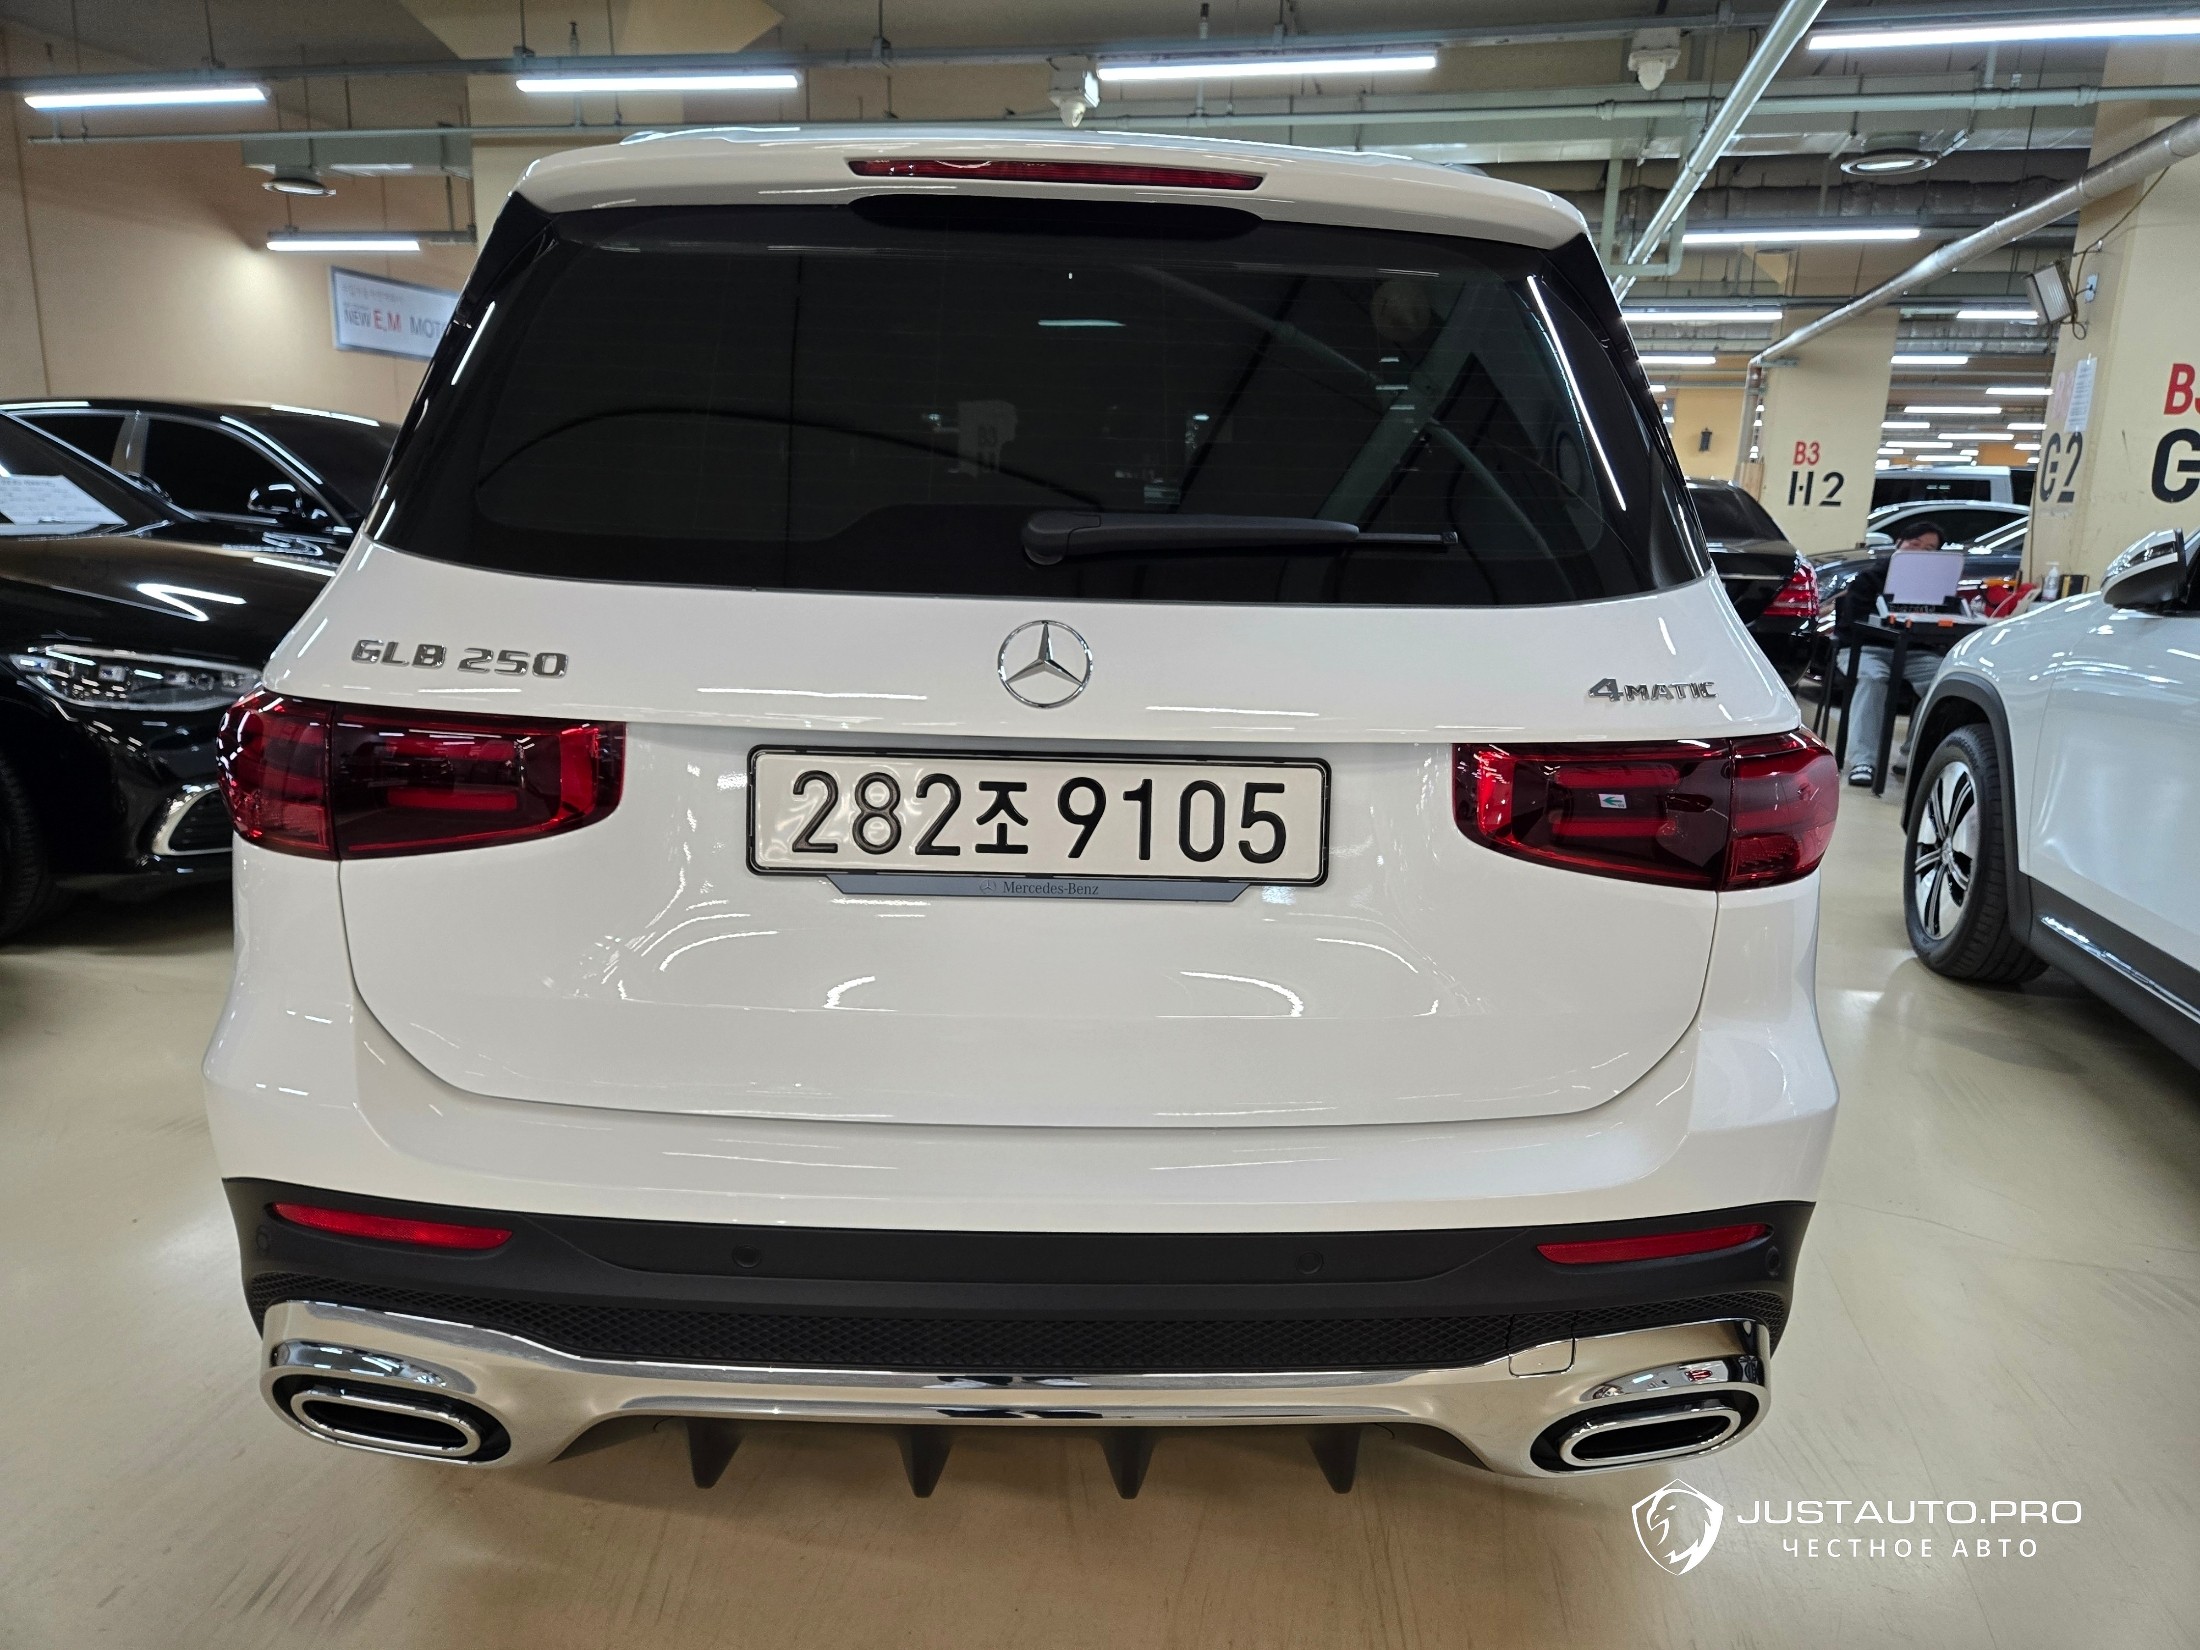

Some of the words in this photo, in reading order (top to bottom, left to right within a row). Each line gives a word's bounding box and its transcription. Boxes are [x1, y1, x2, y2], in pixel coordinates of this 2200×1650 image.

[408, 316, 447, 338] MOT
[2164, 363, 2200, 415] B
[1793, 441, 1820, 466] B3
[2040, 432, 2083, 503] G2
[1788, 471, 1845, 506] H2
[351, 639, 447, 669] GLB
[457, 647, 569, 679] 250
[1588, 678, 1717, 702] 4MATIC
[792, 770, 1029, 856] 282조
[1057, 776, 1287, 864] 9105
[1003, 881, 1099, 896] Mercedes-Benz
